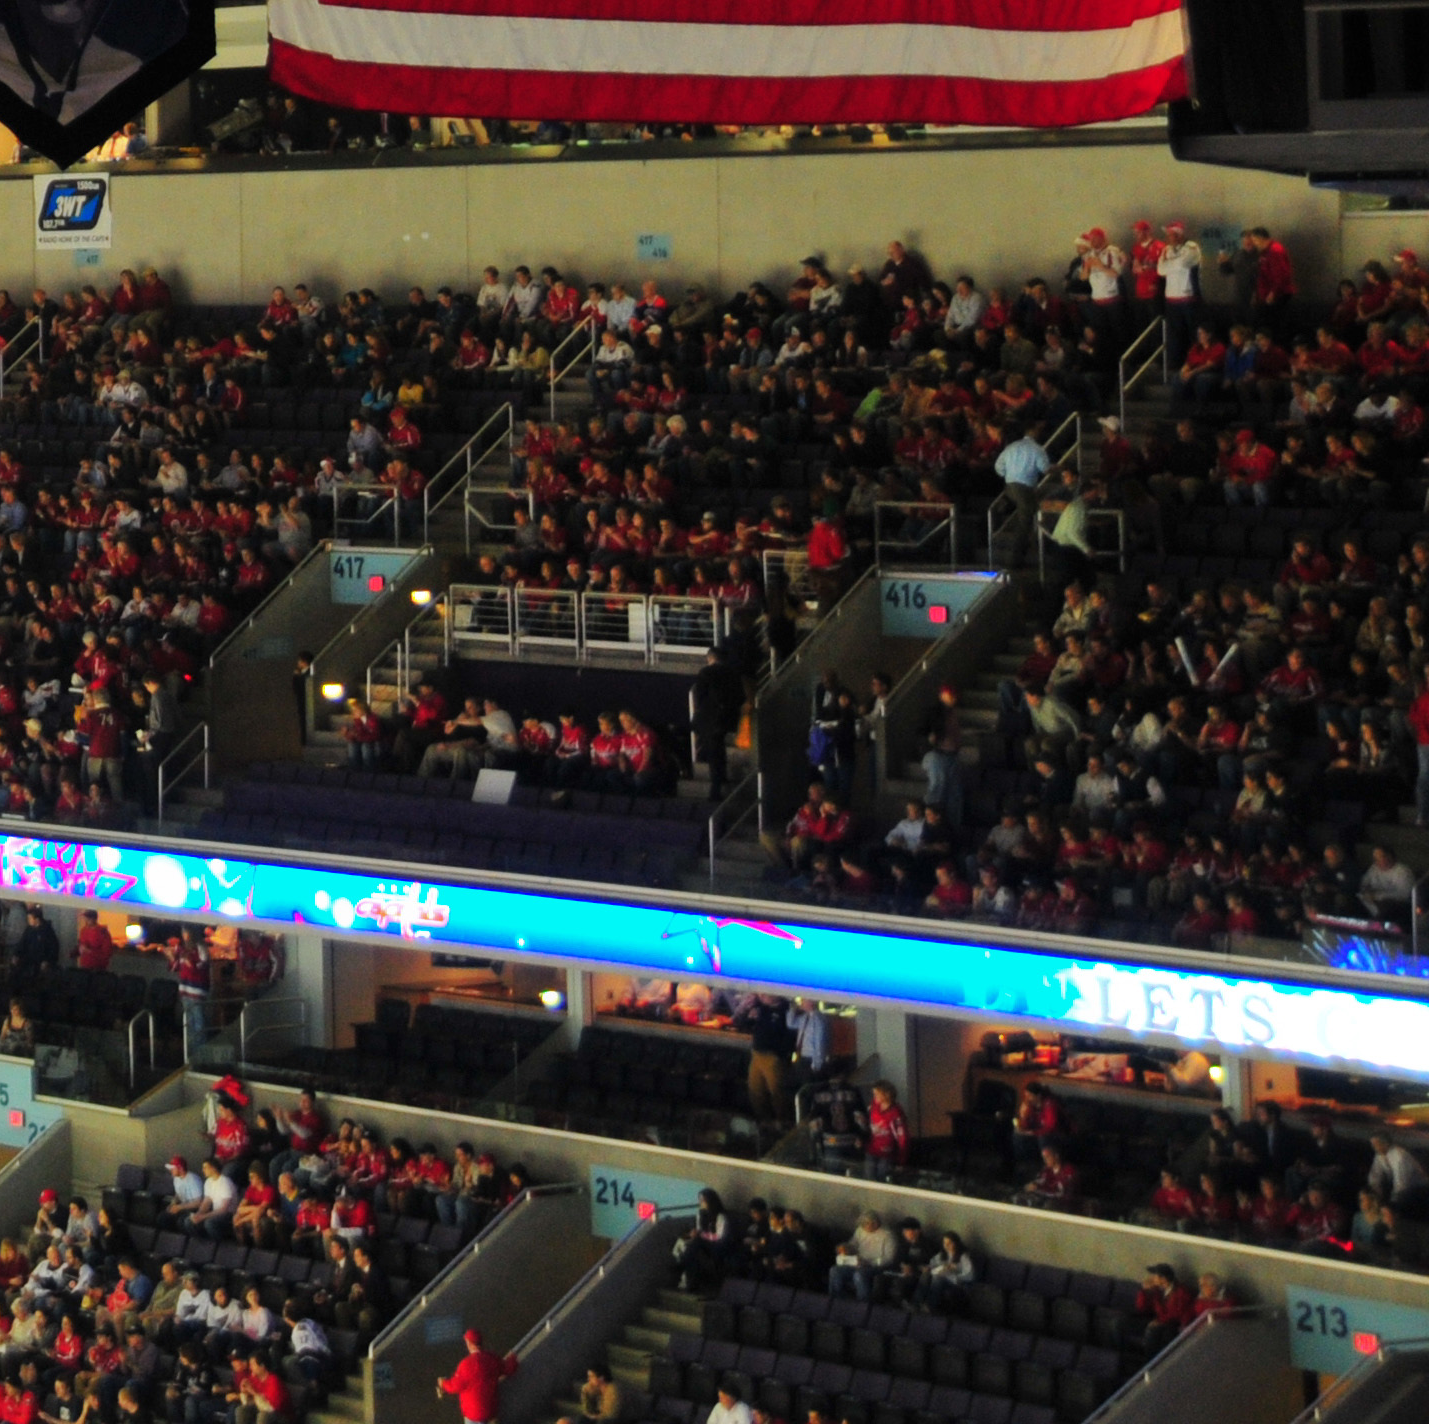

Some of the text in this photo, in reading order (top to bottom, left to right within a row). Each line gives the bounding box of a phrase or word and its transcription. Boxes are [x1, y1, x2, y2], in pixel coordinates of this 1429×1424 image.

[333, 555, 365, 579] 417
[886, 580, 927, 610] 416
[1095, 976, 1276, 1046] LETS
[595, 1177, 635, 1209] 214
[1296, 1301, 1350, 1339] 213
